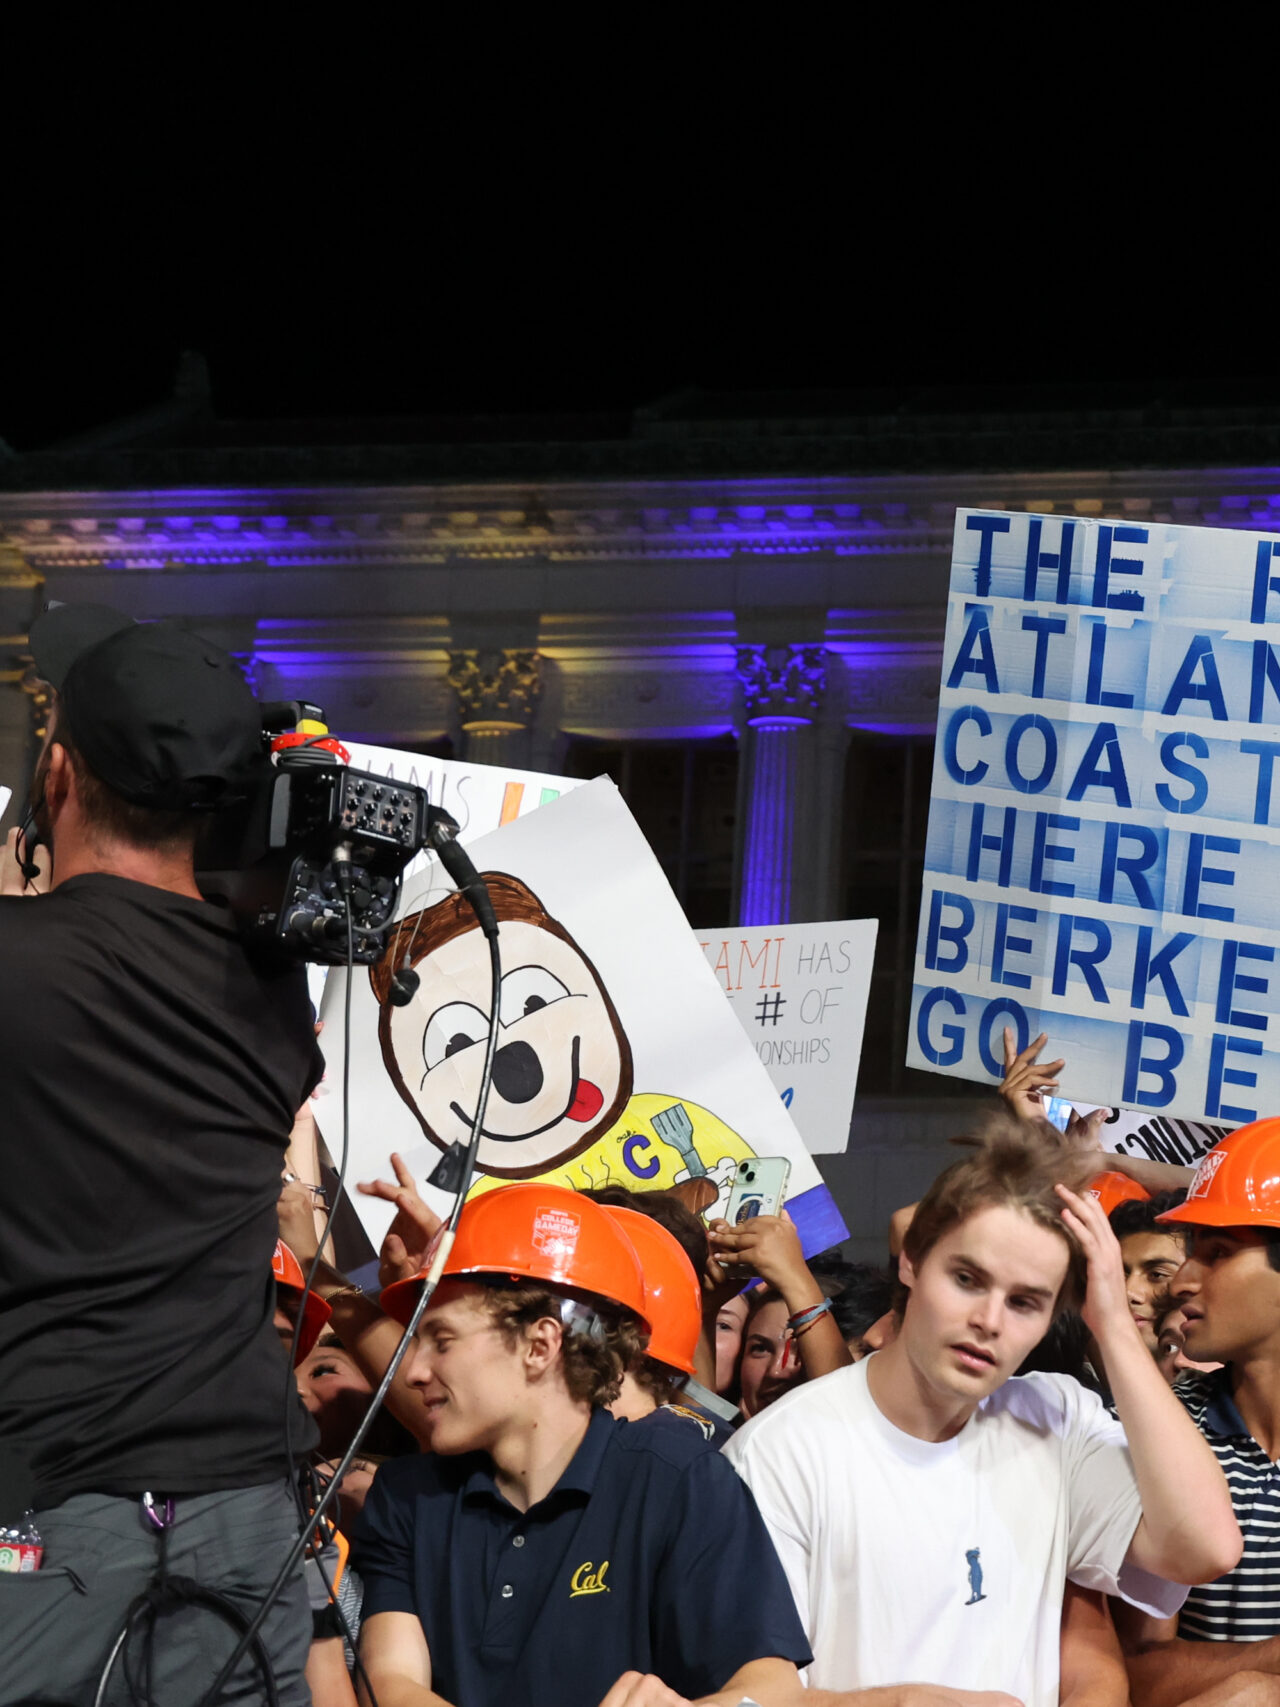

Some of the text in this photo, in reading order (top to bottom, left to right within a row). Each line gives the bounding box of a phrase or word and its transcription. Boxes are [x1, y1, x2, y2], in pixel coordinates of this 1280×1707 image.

[965, 516, 1149, 611] THE
[966, 803, 1241, 923] HERE
[700, 937, 851, 991] AMI HAS
[800, 987, 843, 1024] OF
[917, 986, 1030, 1079] GO
[534, 1217, 580, 1236] GAMEDAY
[569, 1560, 609, 1598] Cal
